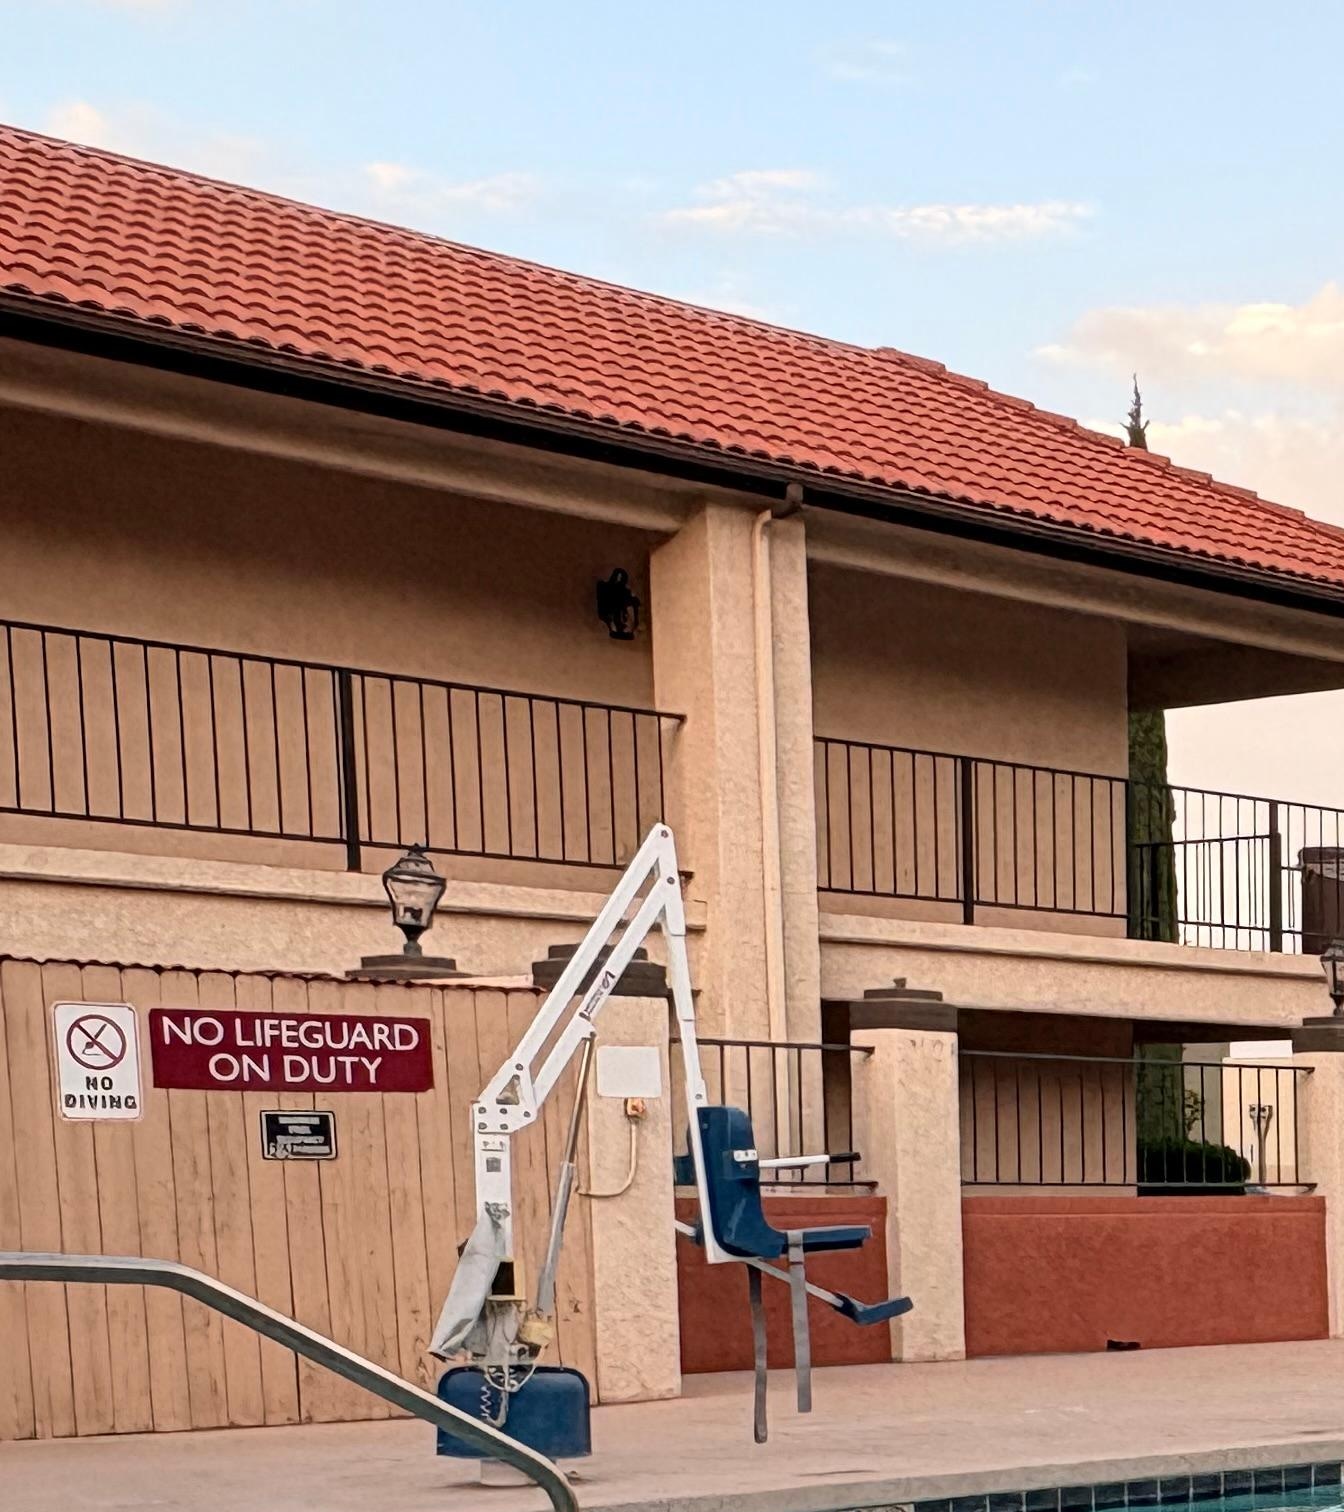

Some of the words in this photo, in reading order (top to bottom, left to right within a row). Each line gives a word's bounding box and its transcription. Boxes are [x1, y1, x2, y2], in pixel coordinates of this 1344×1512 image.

[161, 1015, 224, 1046] NO
[234, 1018, 420, 1051] LIFEGUARD
[208, 1053, 270, 1083] ON
[282, 1055, 383, 1084] DUTY
[85, 1075, 113, 1091] NO
[64, 1093, 137, 1110] DIVING
